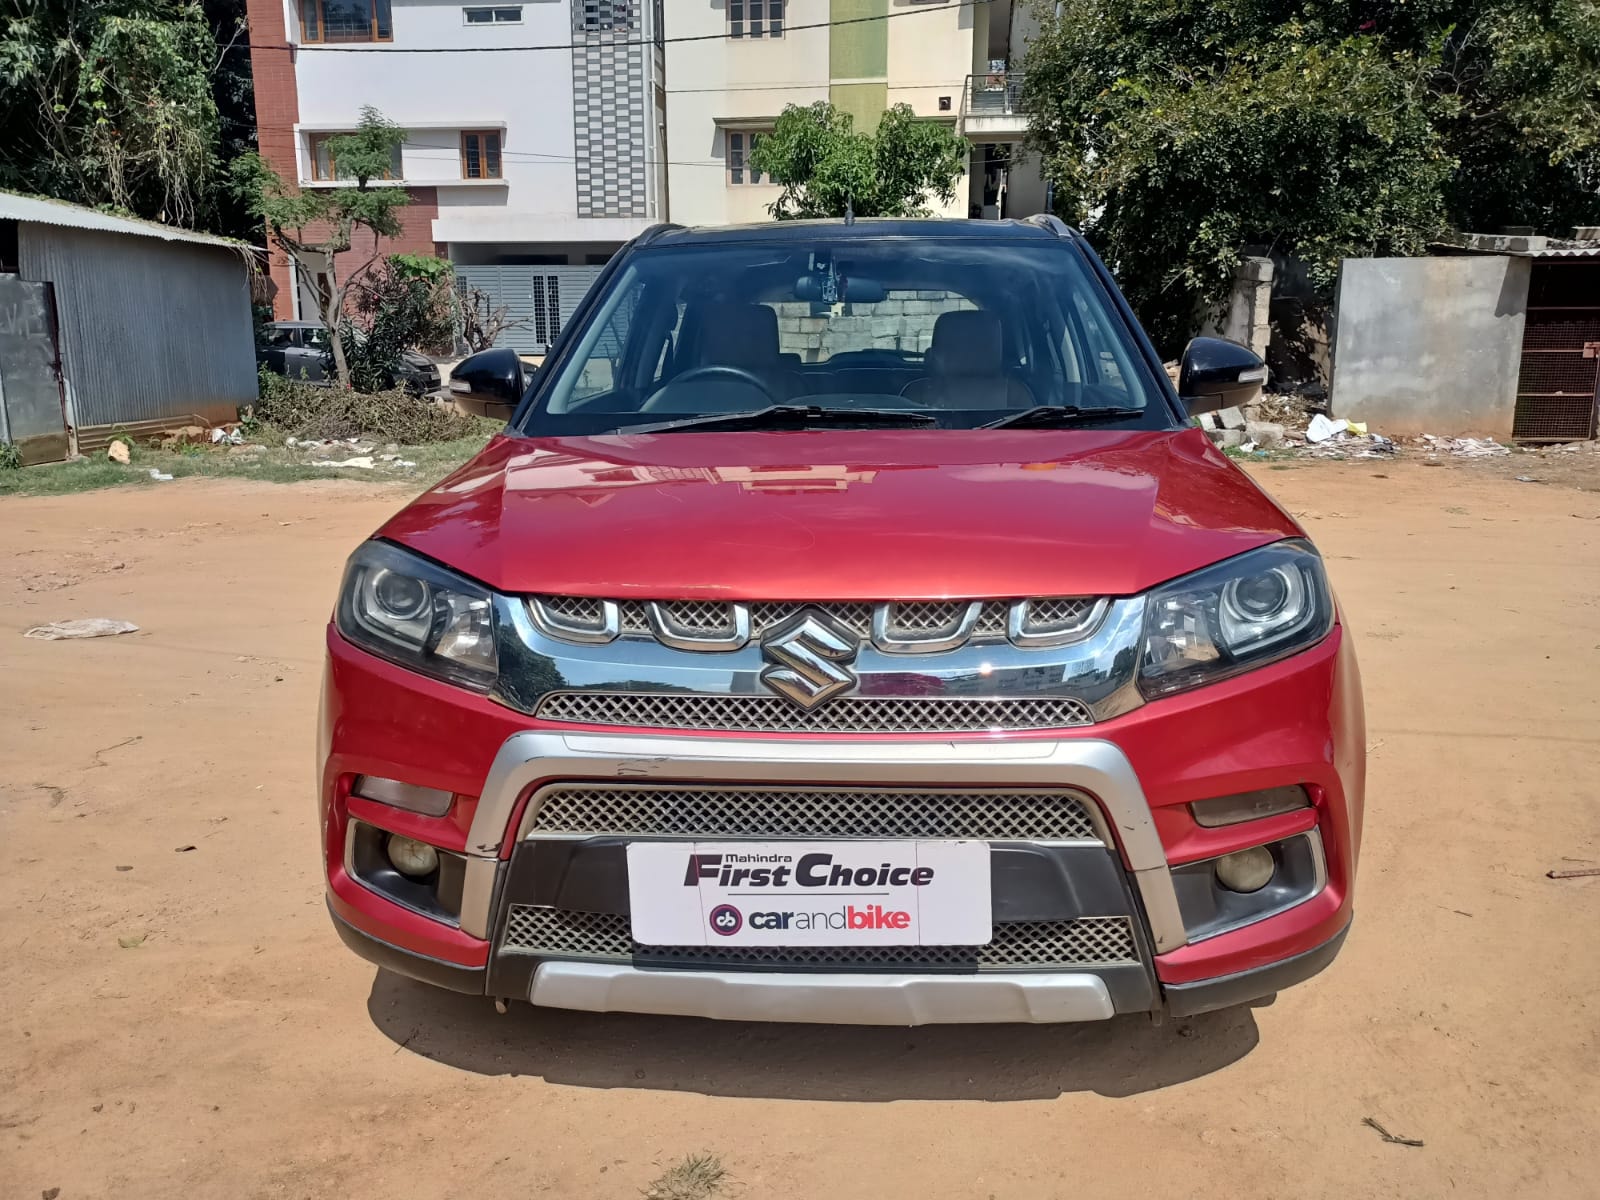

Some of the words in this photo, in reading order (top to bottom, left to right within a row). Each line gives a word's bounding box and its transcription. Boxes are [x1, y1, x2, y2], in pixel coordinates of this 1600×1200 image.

[684, 853, 791, 887] First
[795, 853, 934, 887] Choice
[725, 854, 792, 863] Mahindra
[748, 904, 911, 930] carandbike
